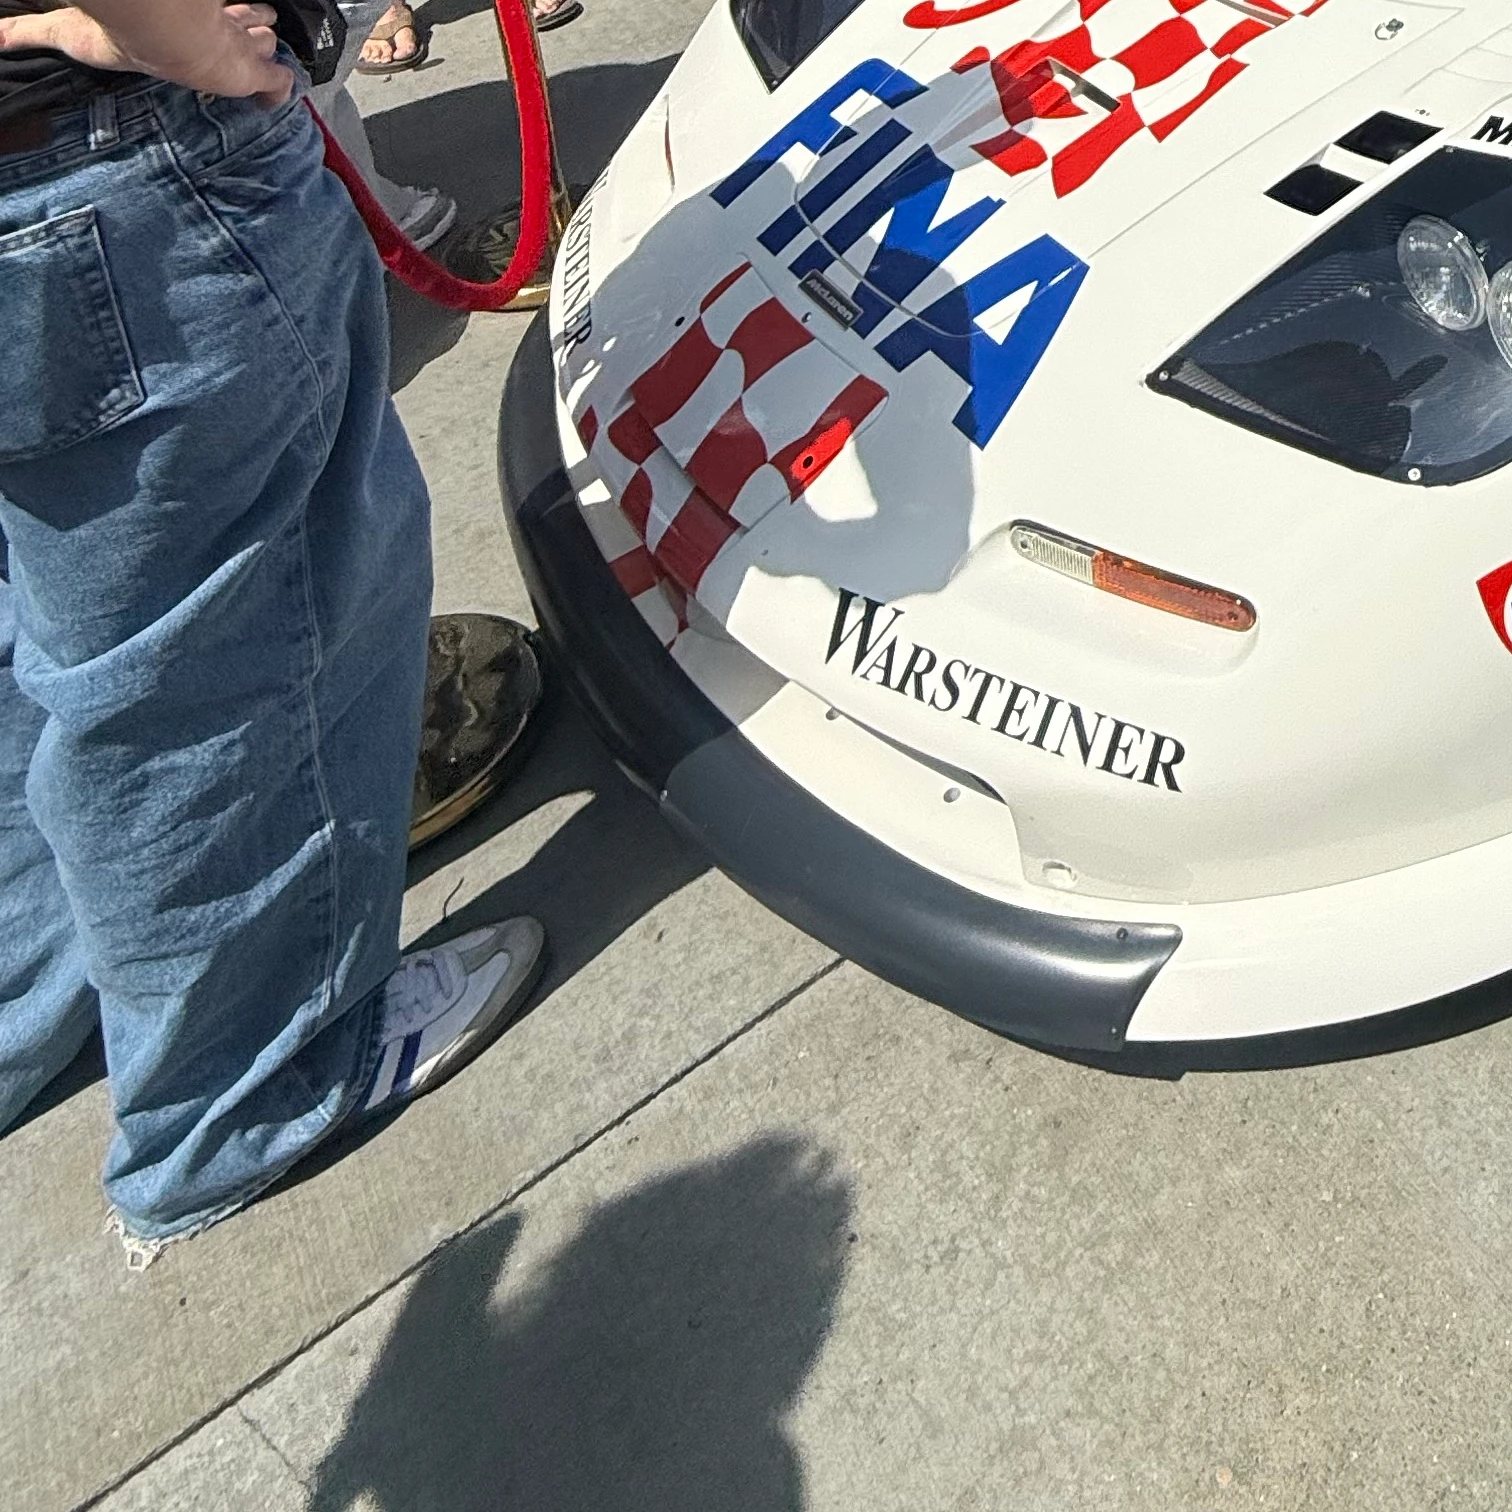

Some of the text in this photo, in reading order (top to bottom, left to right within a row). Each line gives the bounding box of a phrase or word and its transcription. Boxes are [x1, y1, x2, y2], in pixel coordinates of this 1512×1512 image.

[709, 57, 1091, 451] FINA
[805, 278, 854, 322] McLaren
[825, 586, 1186, 793] WARSTEINER
